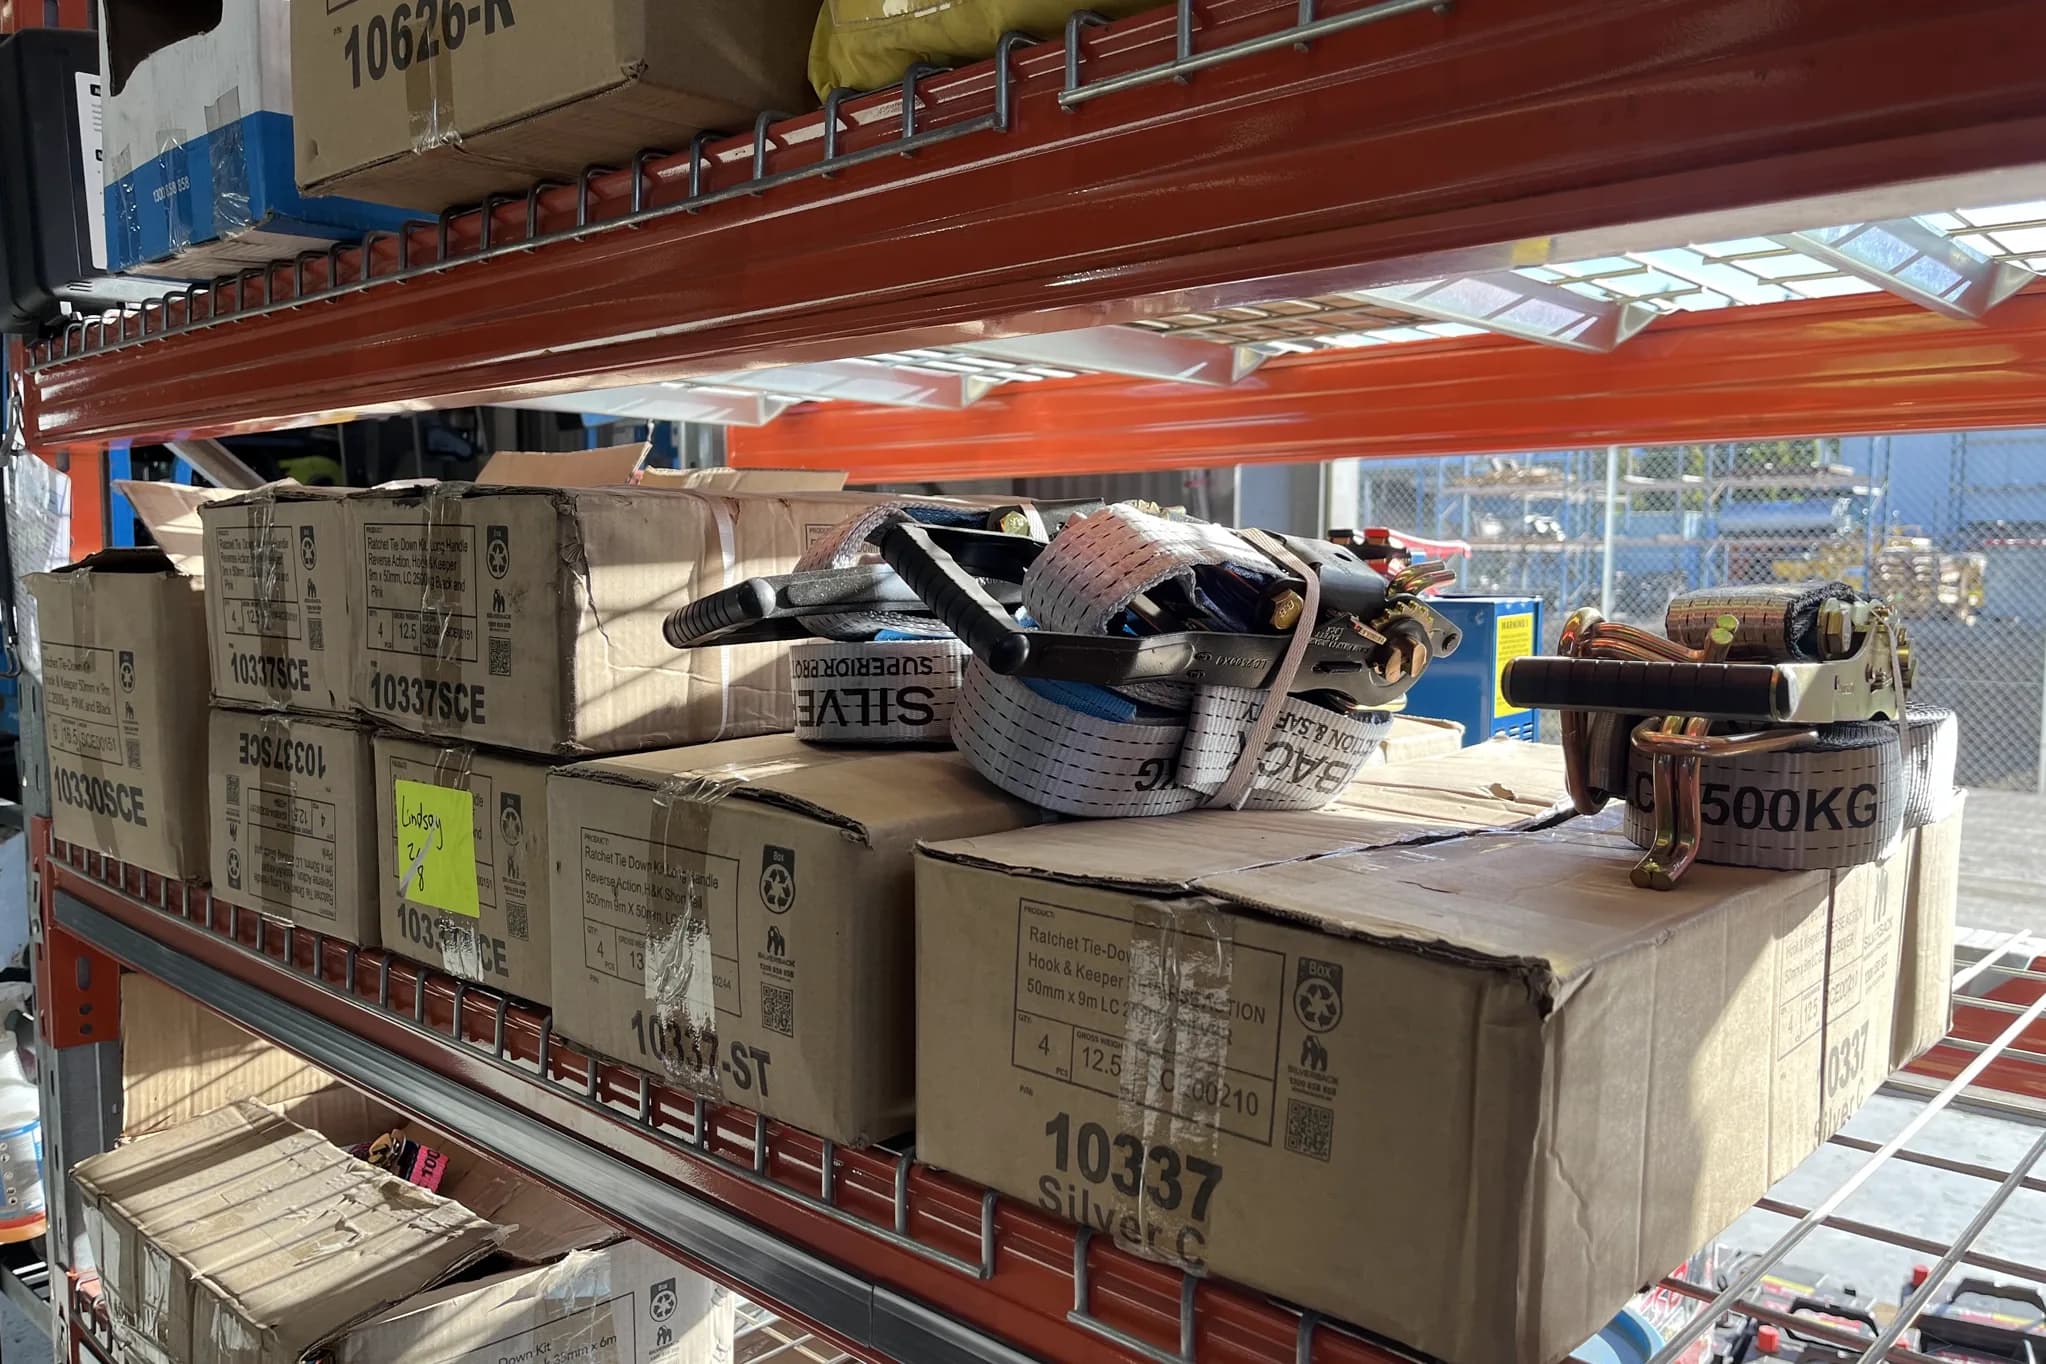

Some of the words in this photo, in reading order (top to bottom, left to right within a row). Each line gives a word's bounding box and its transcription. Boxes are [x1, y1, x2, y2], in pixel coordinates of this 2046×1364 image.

[368, 538, 389, 551] Ratchet
[389, 538, 398, 550] Tie
[400, 538, 418, 550] Down
[445, 541, 468, 553] Handle
[368, 553, 392, 566] Reverse
[435, 558, 458, 573] Keeper
[370, 585, 383, 598] Pink
[403, 573, 412, 585] LC
[453, 579, 466, 592] and
[231, 610, 237, 623] 4
[378, 622, 384, 639] 4
[399, 623, 417, 641] 12.5
[231, 651, 312, 692] 10337SCE
[824, 656, 933, 677] SUPERIOR
[371, 671, 487, 726] 10337SCE
[794, 686, 935, 727] SILVE
[1314, 724, 1329, 742] &
[239, 732, 327, 779] 10337SCE
[54, 765, 148, 828] 10330SCE
[1700, 783, 1879, 833] 500KG
[584, 846, 614, 865] Ratchet
[614, 852, 627, 867] Tie
[629, 855, 653, 872] Down
[666, 864, 687, 885] Long
[773, 850, 785, 863] Box
[585, 869, 616, 889] Reverse
[644, 884, 663, 900] H&K
[585, 890, 613, 910] 350mm
[613, 898, 626, 913] 9m
[627, 899, 635, 914] X
[1024, 905, 1055, 918] PRODUCT:
[597, 940, 604, 957] 4
[1029, 926, 1079, 951] Ratchet
[1028, 951, 1061, 974] Hook
[1063, 961, 1072, 976] &
[1076, 962, 1124, 989] Keeper
[1308, 960, 1332, 979] Box
[1027, 978, 1065, 1001] 50mm
[1067, 992, 1076, 1005] x
[1078, 990, 1098, 1009] 9m
[1101, 996, 1120, 1015] LC
[1038, 1033, 1050, 1056] 4
[1076, 1030, 1099, 1044] GROSS
[1100, 1037, 1124, 1050] WEIGH
[1082, 1046, 1121, 1077] 12.5
[1828, 1018, 1870, 1098] 0337
[1055, 1066, 1069, 1077] PCS
[1287, 1065, 1339, 1086] SILVERBACK
[1045, 1111, 1223, 1222] 10337
[1038, 1174, 1163, 1247] Silver
[1176, 1226, 1206, 1267] C
[534, 1341, 553, 1359] Kit
[591, 1343, 598, 1353] x
[600, 1334, 617, 1349] 6m
